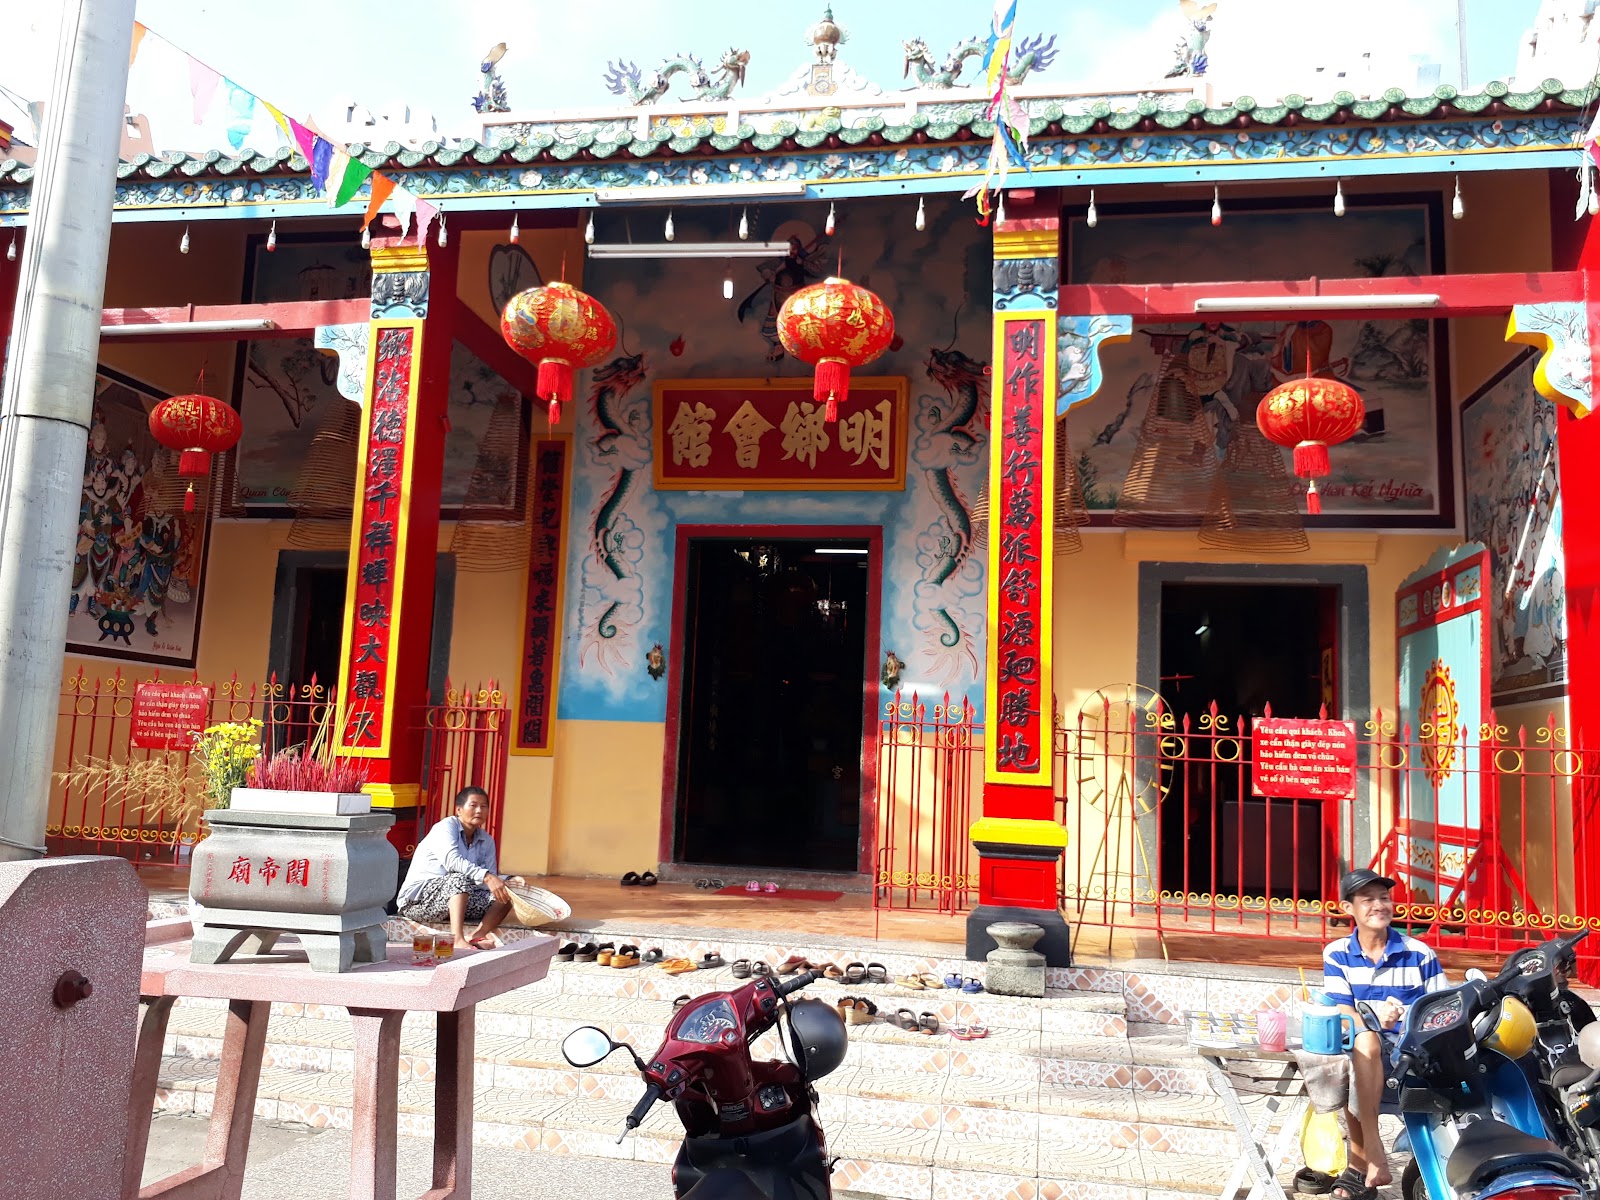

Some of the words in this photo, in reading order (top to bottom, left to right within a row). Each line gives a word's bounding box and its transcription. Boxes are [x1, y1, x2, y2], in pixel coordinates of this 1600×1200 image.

[1260, 726, 1274, 734] Yêu
[1275, 726, 1288, 734] cầu
[1301, 727, 1323, 736] khách
[1283, 739, 1300, 748] thận
[1260, 750, 1273, 758] bảo
[1274, 750, 1291, 759] hiểm
[1260, 762, 1274, 770] Yêu
[1275, 762, 1288, 771] cầu
[1289, 763, 1298, 771] bà
[1324, 765, 1335, 773] xin
[1336, 765, 1350, 773] bán
[1270, 774, 1279, 782] số
[1285, 775, 1299, 783] bên
[1300, 776, 1320, 785] ngoài
